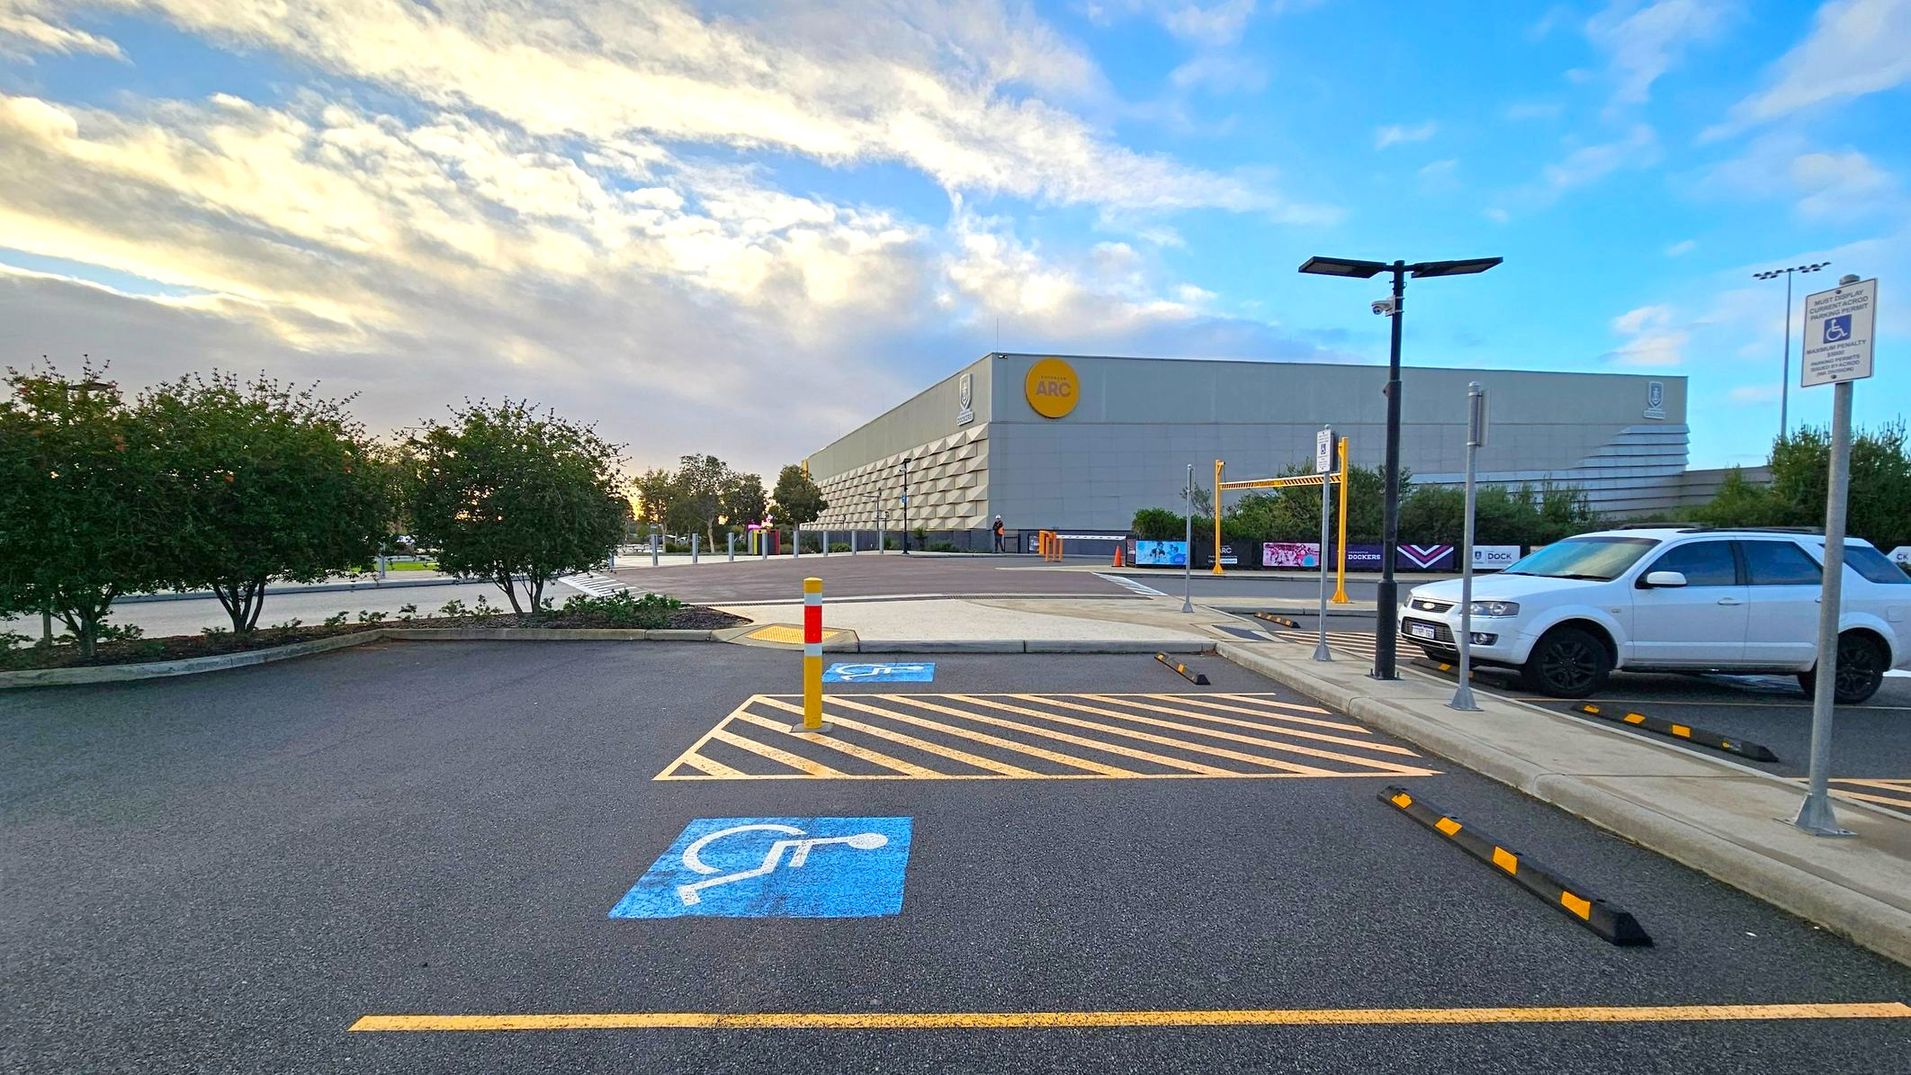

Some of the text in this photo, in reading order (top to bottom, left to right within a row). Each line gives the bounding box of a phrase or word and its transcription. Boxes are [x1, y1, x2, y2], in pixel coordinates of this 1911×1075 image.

[1809, 296, 1868, 314] CURRENT ACROD
[1814, 290, 1864, 306] MUST DISPLAY
[1810, 303, 1868, 320] PARKING PERMIT
[1807, 344, 1836, 354] MAXIMUM
[1837, 339, 1866, 349] PENALTY
[1036, 380, 1072, 397] ARC
